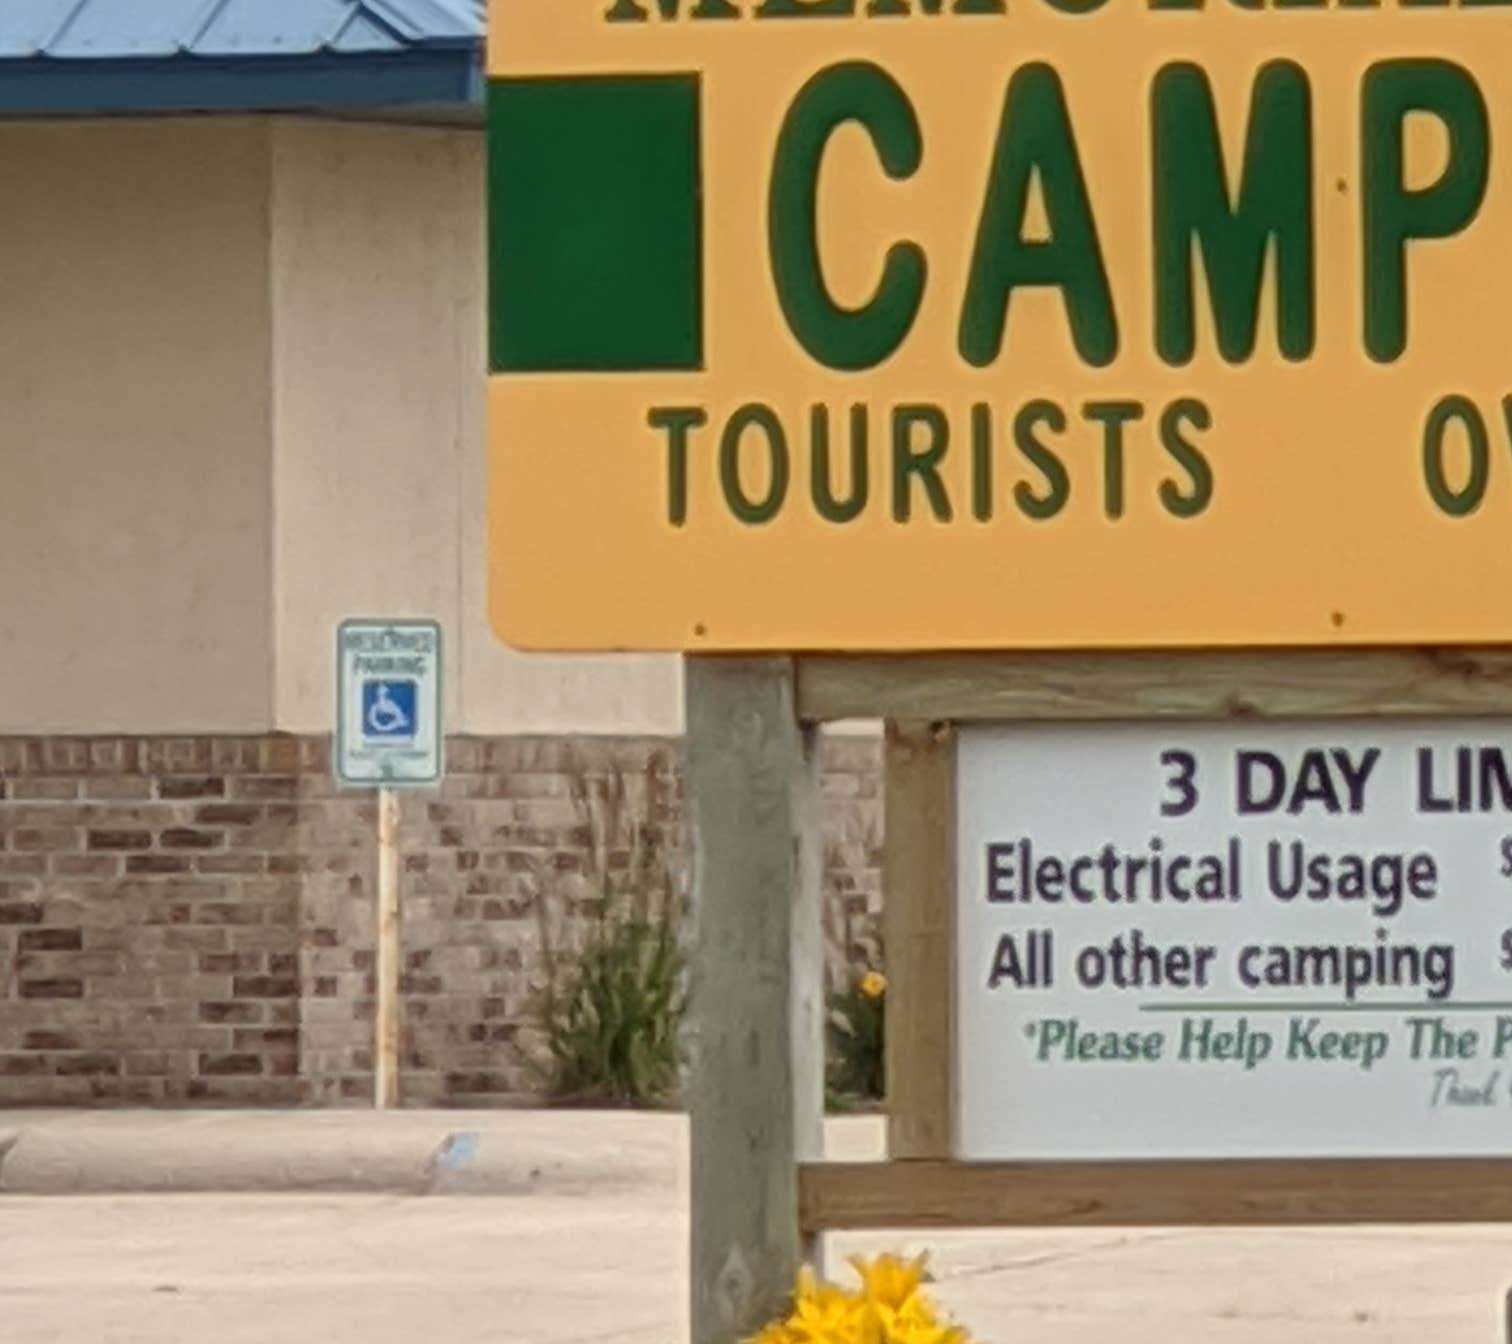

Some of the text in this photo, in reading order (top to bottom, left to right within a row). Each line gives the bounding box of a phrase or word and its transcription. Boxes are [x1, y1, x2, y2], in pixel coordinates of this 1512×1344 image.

[646, 397, 1214, 529] TOURISTS
[1160, 748, 1199, 817] 3
[1236, 747, 1382, 815] DAY
[986, 837, 1242, 904] Electrical
[1268, 839, 1438, 918] Usage
[987, 929, 1054, 989] All
[1076, 928, 1217, 989] other
[1238, 927, 1455, 1001] camping
[1177, 1017, 1273, 1071] Help
[1286, 1017, 1391, 1071] Keep
[1404, 1016, 1481, 1061] The
